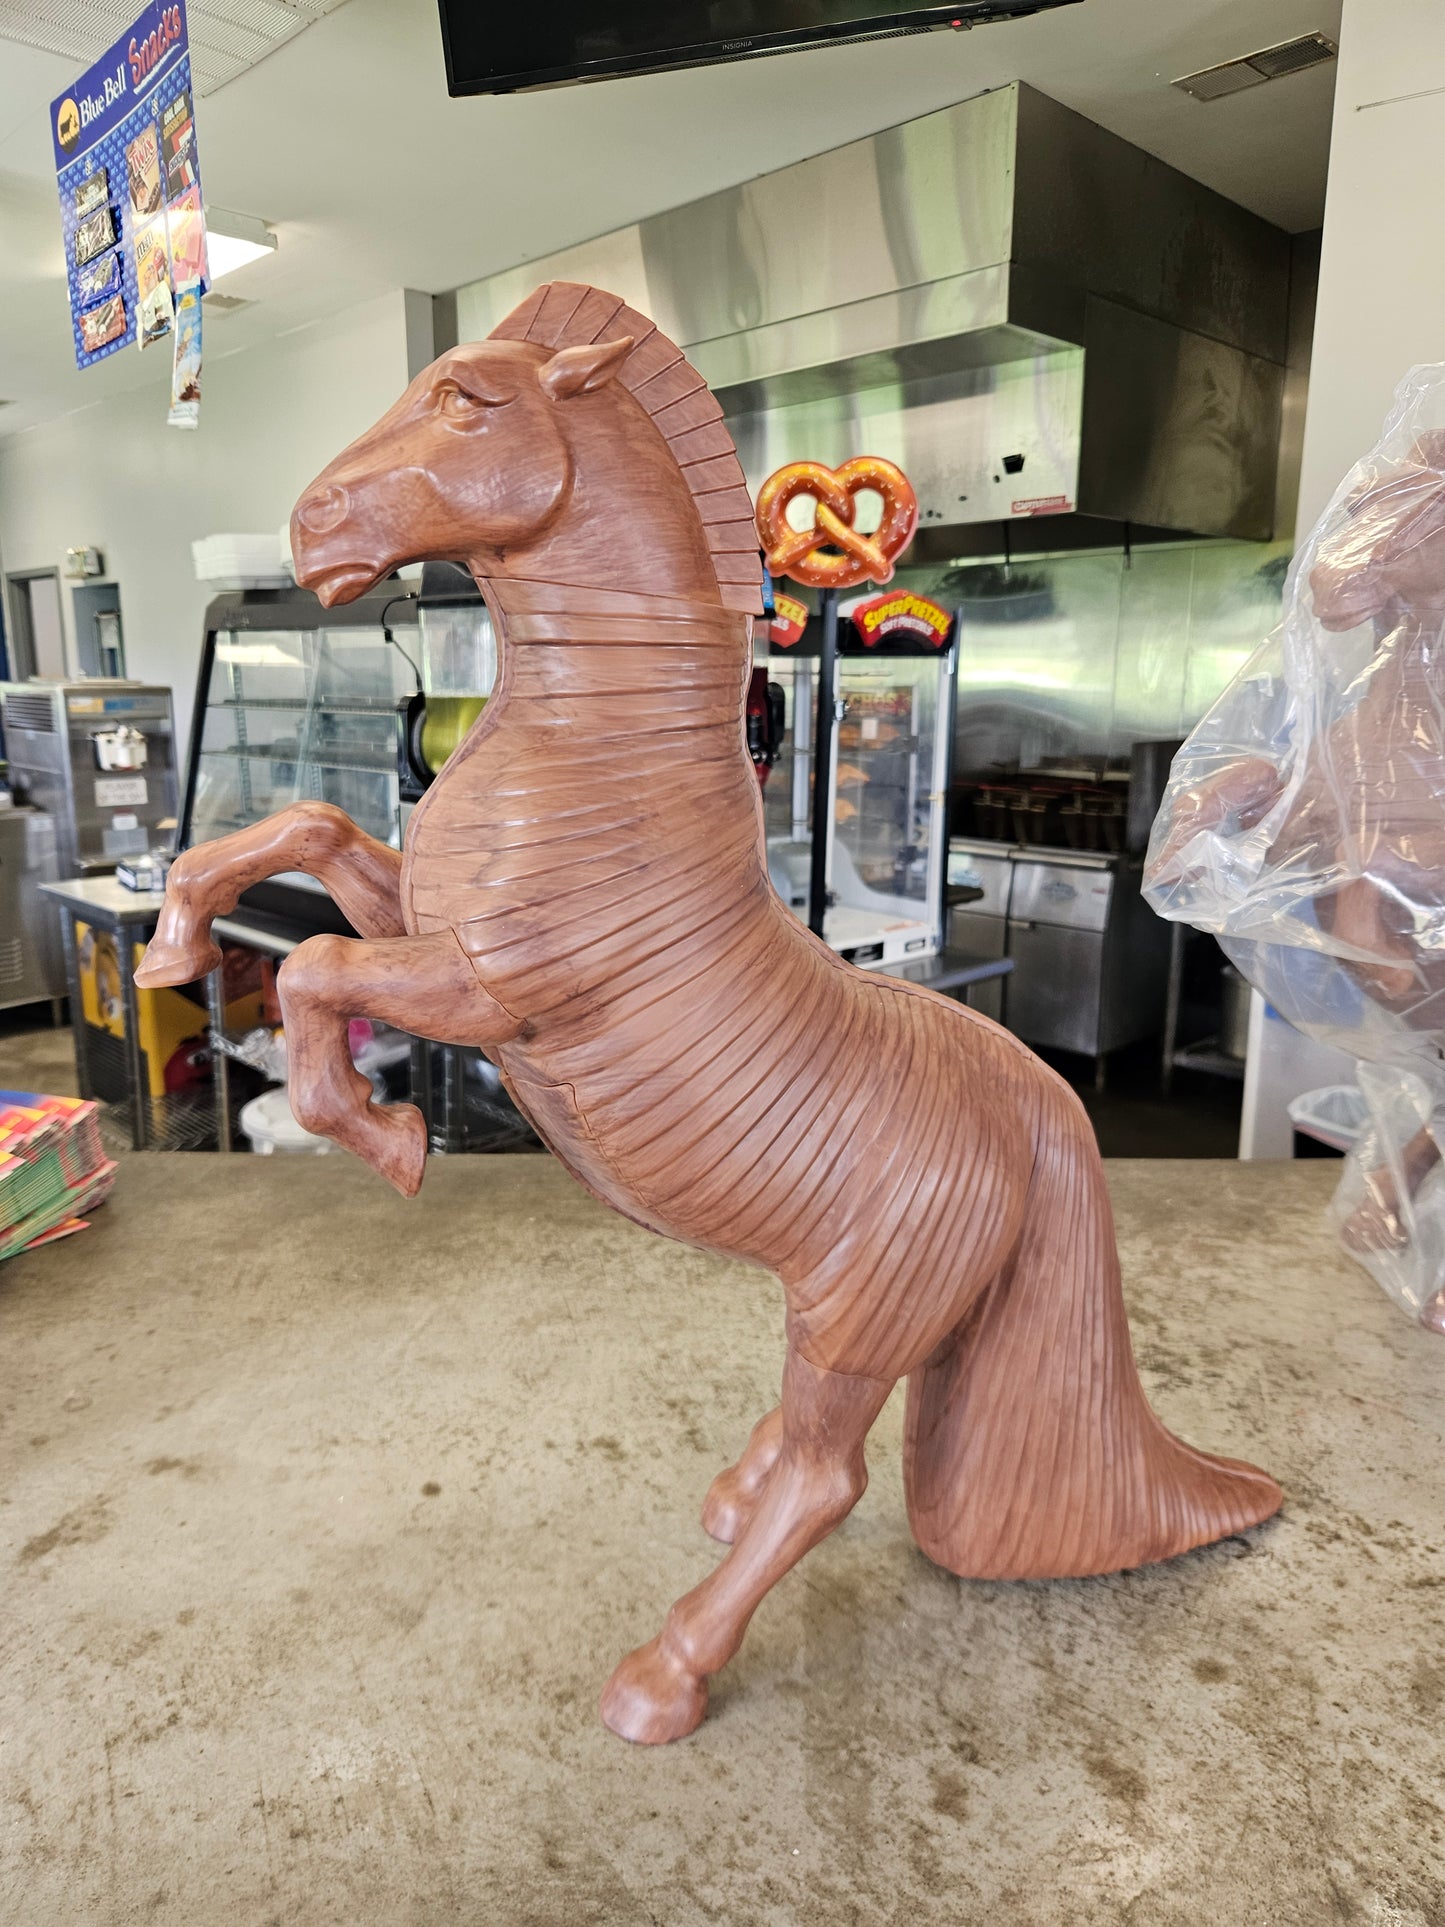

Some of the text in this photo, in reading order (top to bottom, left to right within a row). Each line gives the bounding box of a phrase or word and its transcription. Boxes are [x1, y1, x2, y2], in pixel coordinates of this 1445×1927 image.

[722, 40, 753, 51] INSIGNIA
[79, 4, 182, 128] Blue Bell Snacks
[129, 138, 155, 178] TWIX
